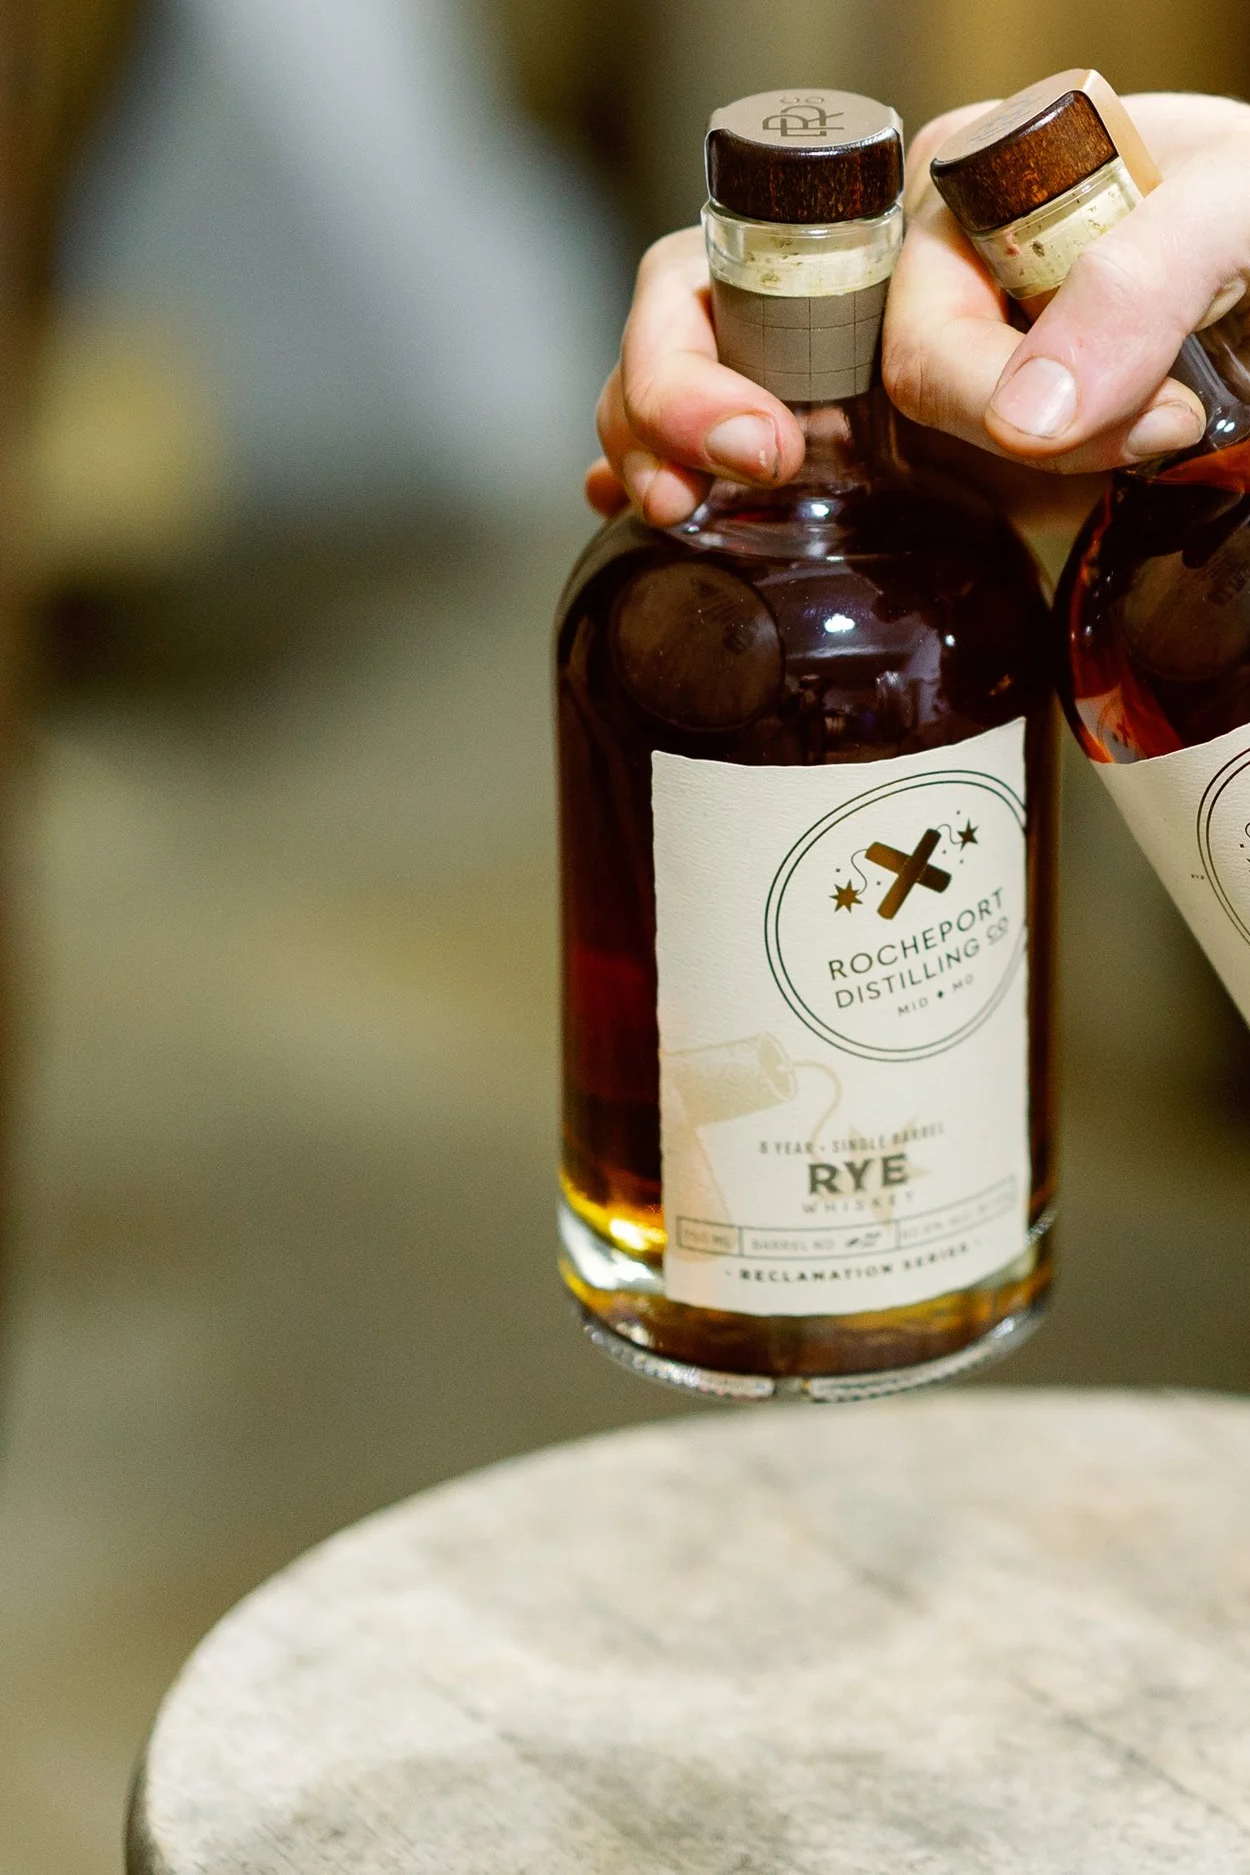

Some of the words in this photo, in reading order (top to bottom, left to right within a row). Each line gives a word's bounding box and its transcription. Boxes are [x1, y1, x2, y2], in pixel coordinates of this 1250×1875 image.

[828, 887, 1004, 980] ROCHEPORT
[835, 938, 980, 1009] DISTILLING
[897, 997, 929, 1016] MID
[952, 974, 974, 993] MO
[773, 1140, 815, 1155] YEAR
[831, 1133, 887, 1154] SINGLE
[808, 1153, 909, 1195] RYE
[802, 1191, 915, 1215] WHISKEY
[740, 1263, 893, 1283] RECLAMATION
